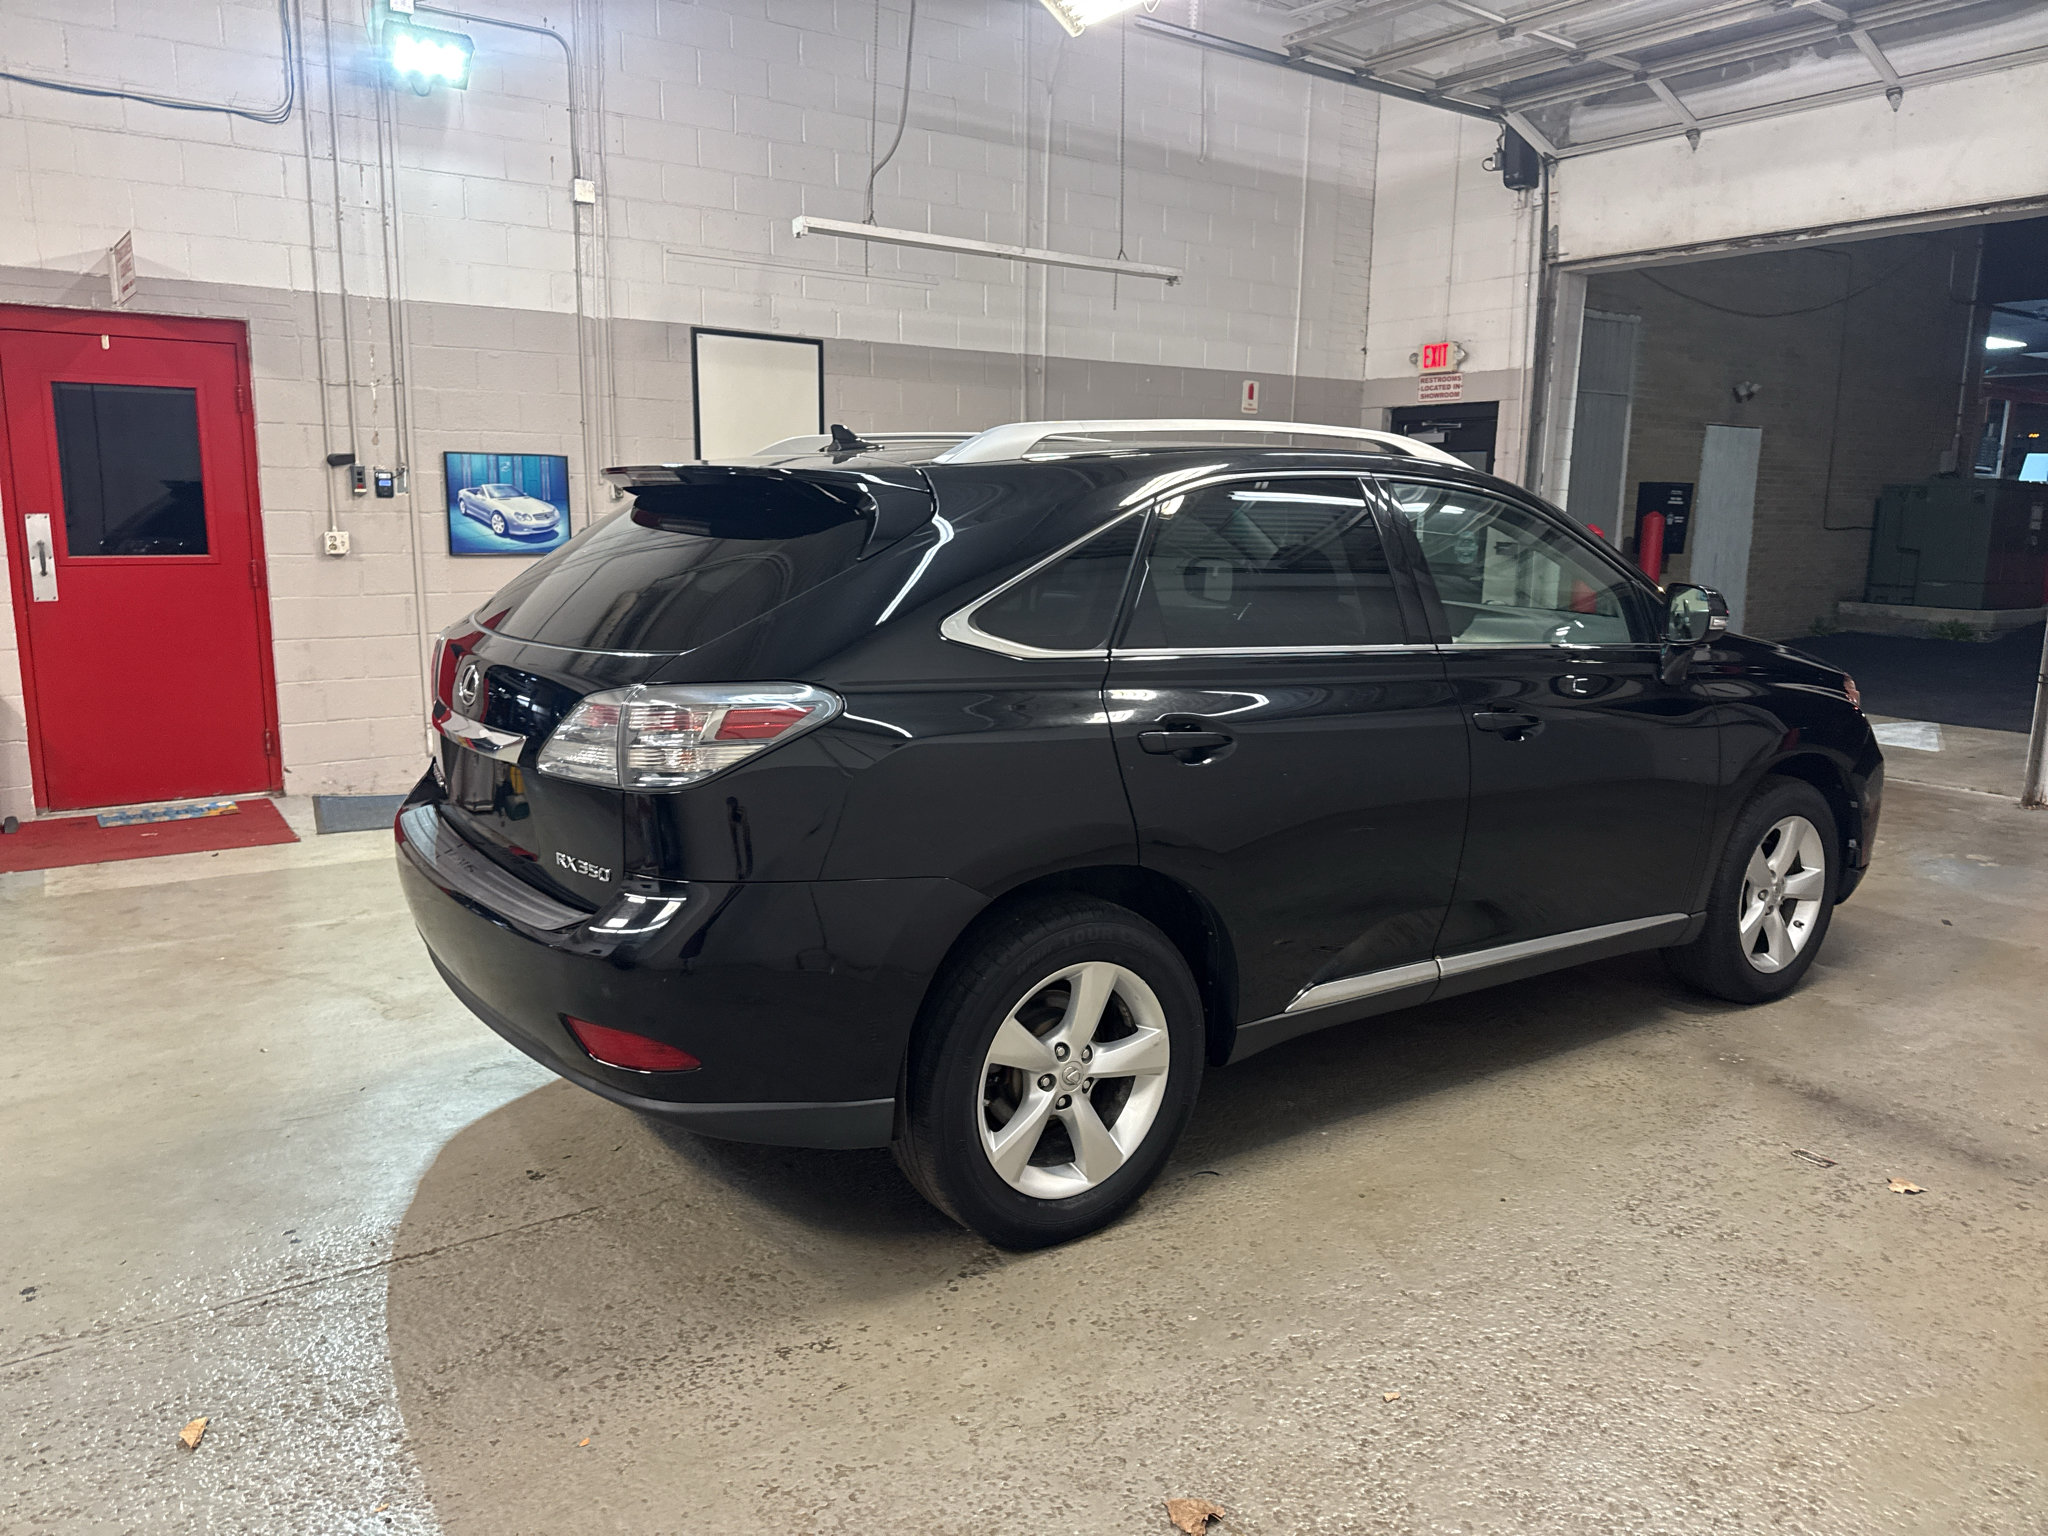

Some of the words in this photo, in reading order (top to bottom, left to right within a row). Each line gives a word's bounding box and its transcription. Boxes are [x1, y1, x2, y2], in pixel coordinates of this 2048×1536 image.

[1423, 343, 1448, 368] EXIT
[1420, 375, 1461, 383] RESTROOMS
[1420, 391, 1460, 399] SHOWROOM
[555, 851, 611, 882] RX350
